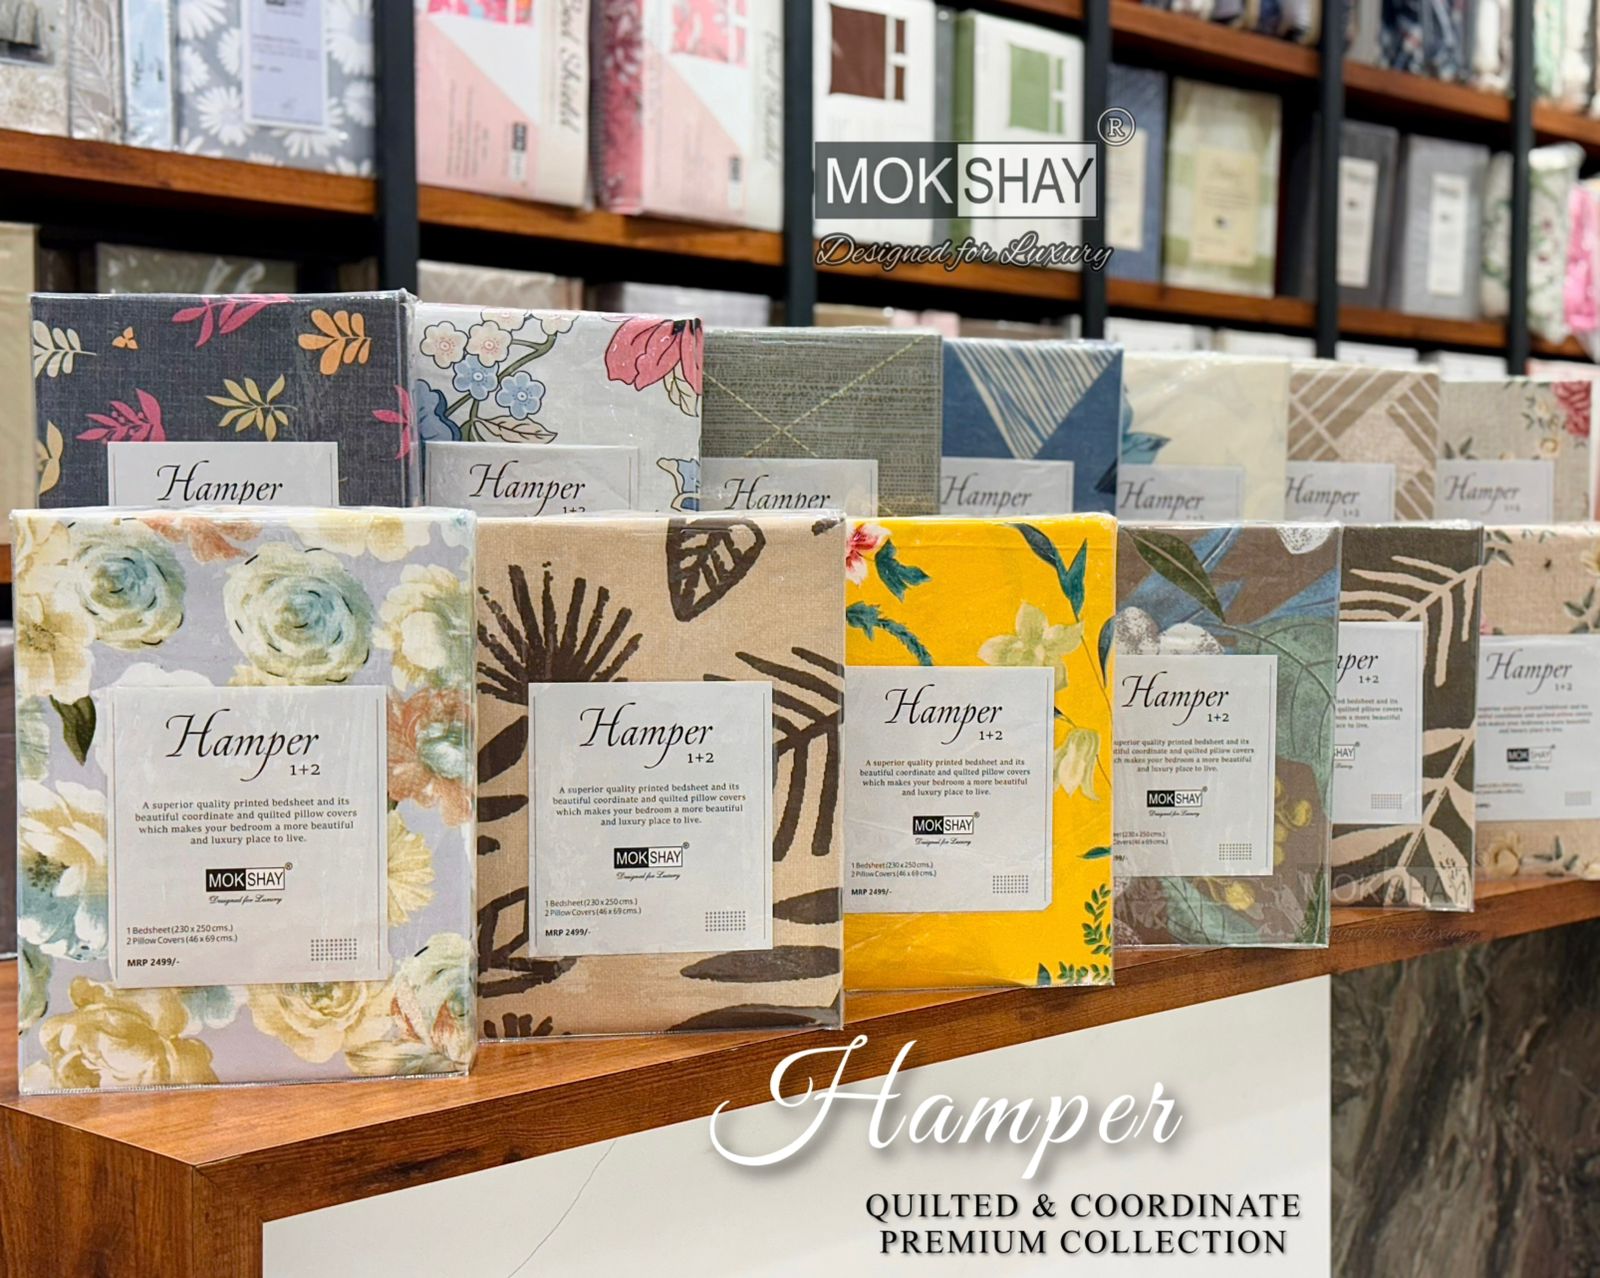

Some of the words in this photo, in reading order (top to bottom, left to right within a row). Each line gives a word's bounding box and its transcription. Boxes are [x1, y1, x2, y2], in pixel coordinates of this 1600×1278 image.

[156, 459, 285, 505] Hamper
[468, 461, 587, 515] Hamper
[943, 471, 1032, 514] Hamper
[1118, 475, 1205, 519] Hamper
[1284, 476, 1360, 517] Hamper
[1444, 474, 1521, 515] Hamper
[1485, 648, 1573, 695] Hamper
[1359, 675, 1379, 684] 1+2
[1554, 683, 1573, 692] 1+2
[1121, 670, 1230, 726] Hamper
[884, 684, 1003, 745] Hamper
[1207, 713, 1230, 722] 1+2
[579, 702, 714, 769] Hamper
[979, 731, 1003, 740] 1+2
[165, 708, 320, 782] Hamper
[687, 753, 715, 764] 1+2
[907, 759, 932, 767] quality
[936, 759, 962, 767] printed
[290, 764, 321, 776] 1+2
[859, 768, 893, 776] beautiful
[953, 768, 979, 776] quilted
[982, 768, 1004, 776] pillow
[567, 785, 604, 794] superior
[606, 785, 636, 794] quality
[638, 784, 669, 793] printed
[672, 783, 708, 791] bedsheet
[918, 788, 942, 796] luxury
[152, 801, 193, 811] superior
[196, 800, 230, 810] quality
[234, 798, 269, 809] printed
[272, 798, 314, 806] bedsheet
[317, 797, 334, 805] and
[552, 796, 590, 804] beautiful
[658, 794, 688, 804] quilted
[690, 794, 717, 803] pillow
[1148, 793, 1202, 804] MOKSHAY
[135, 810, 178, 821] beautiful
[182, 809, 235, 820] coordinate
[236, 810, 254, 819] and
[257, 810, 290, 820] quilted
[294, 809, 324, 819] pillow
[584, 807, 611, 815] makes
[613, 808, 632, 816] your
[705, 804, 742, 812] beautiful
[138, 825, 168, 833] which
[171, 824, 202, 832] makes
[205, 825, 227, 833] your
[230, 823, 271, 831] bedroom
[311, 821, 353, 829] beautiful
[618, 817, 646, 826] luxury
[648, 817, 670, 826] place
[914, 818, 973, 832] MOKSHAY
[190, 836, 208, 844] and
[211, 835, 243, 845] luxury
[246, 834, 270, 844] place
[616, 850, 681, 865] MOKSHAY
[208, 872, 284, 888] MOKSHAY
[565, 928, 590, 936] 2499/-
[127, 958, 148, 966] MRP
[150, 957, 179, 966] 2499/-
